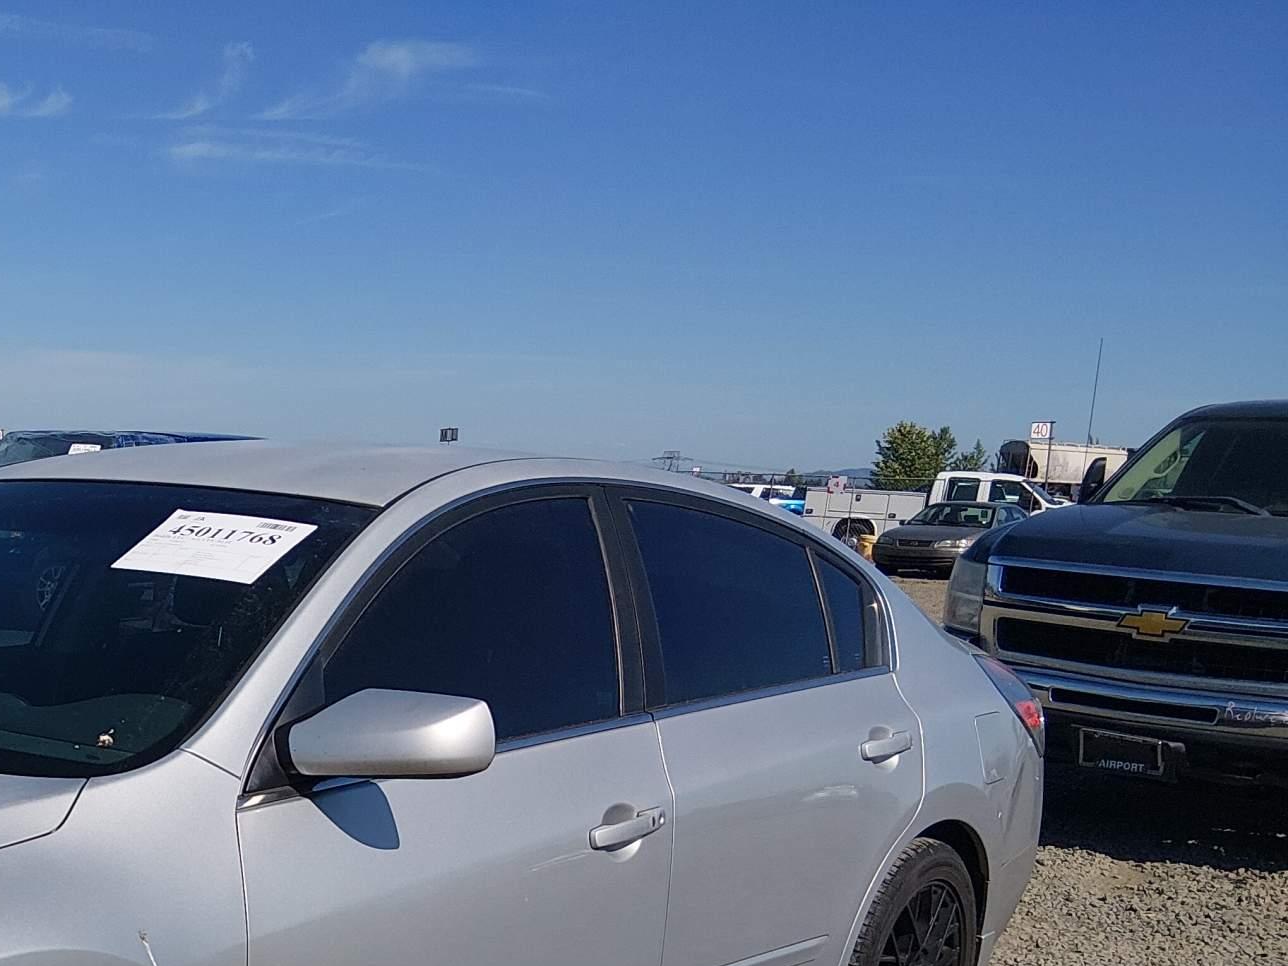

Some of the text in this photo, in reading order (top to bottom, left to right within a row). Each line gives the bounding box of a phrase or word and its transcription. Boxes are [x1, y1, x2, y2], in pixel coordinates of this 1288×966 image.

[1032, 423, 1048, 437] 40
[168, 525, 282, 546] 45011768
[1097, 759, 1145, 772] AIRPORT
